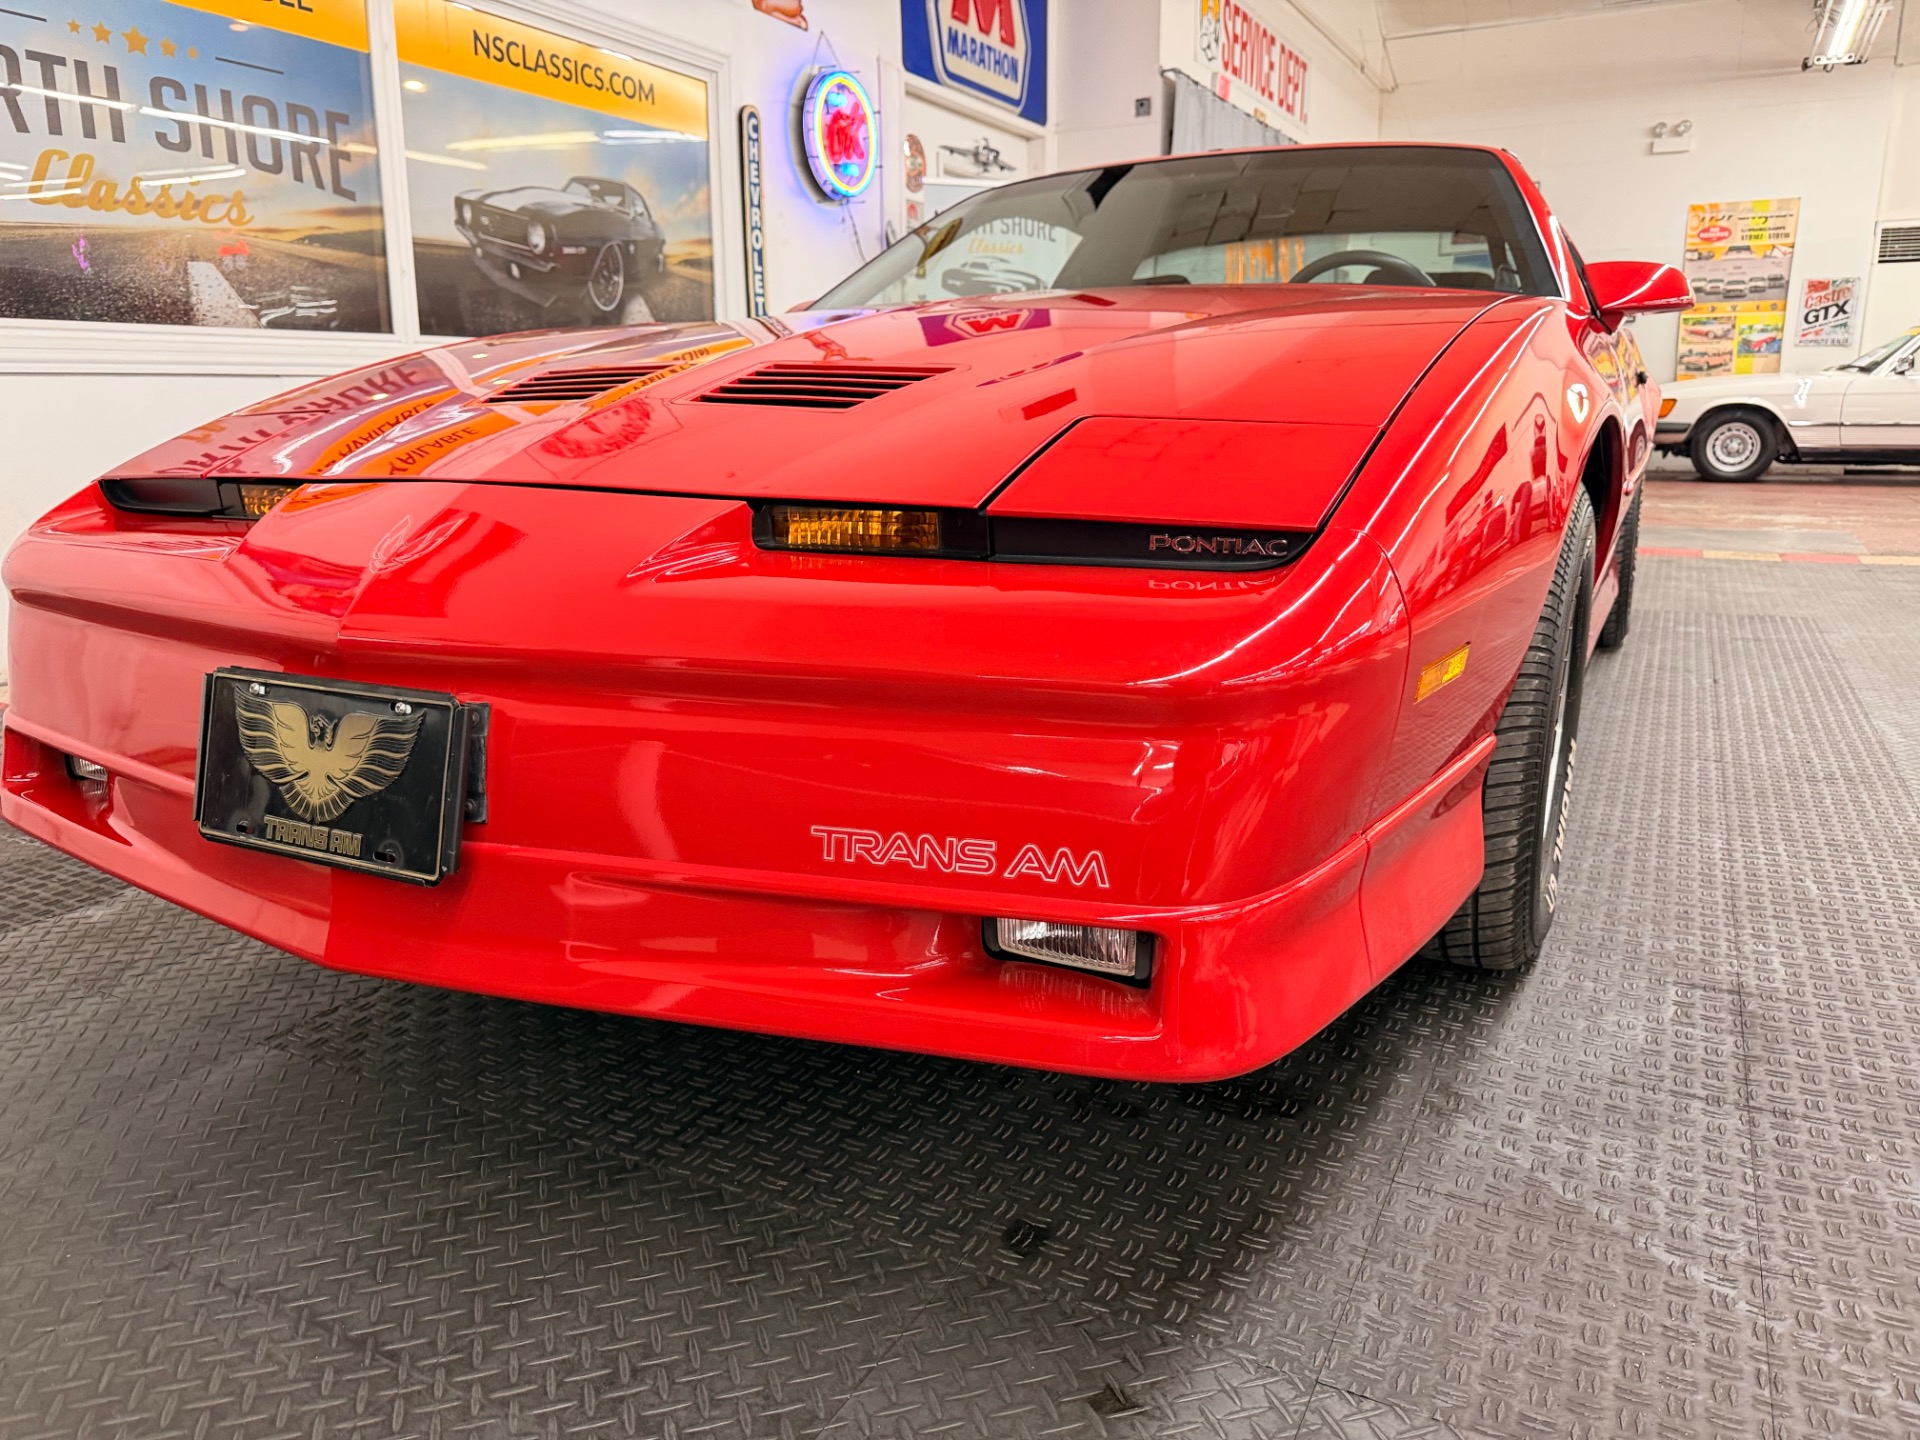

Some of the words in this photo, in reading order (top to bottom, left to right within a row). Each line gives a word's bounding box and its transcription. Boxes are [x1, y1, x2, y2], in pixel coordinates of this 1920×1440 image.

[472, 28, 657, 106] NSCLASSICS.COM
[946, 25, 1020, 84] MARATHON
[1221, 0, 1276, 102] SERVICE
[148, 75, 357, 202] SHORE
[26, 148, 256, 227] Classics
[748, 117, 765, 317] CHEVROLET
[1803, 298, 1851, 325] GTX
[1804, 286, 1853, 309] Castro
[1149, 533, 1288, 556] PONTIAC
[264, 814, 330, 850] TRANS
[329, 828, 364, 857] AM
[1553, 737, 1577, 863] RADIAL
[810, 825, 997, 876] TRANS
[1002, 843, 1111, 889] AM
